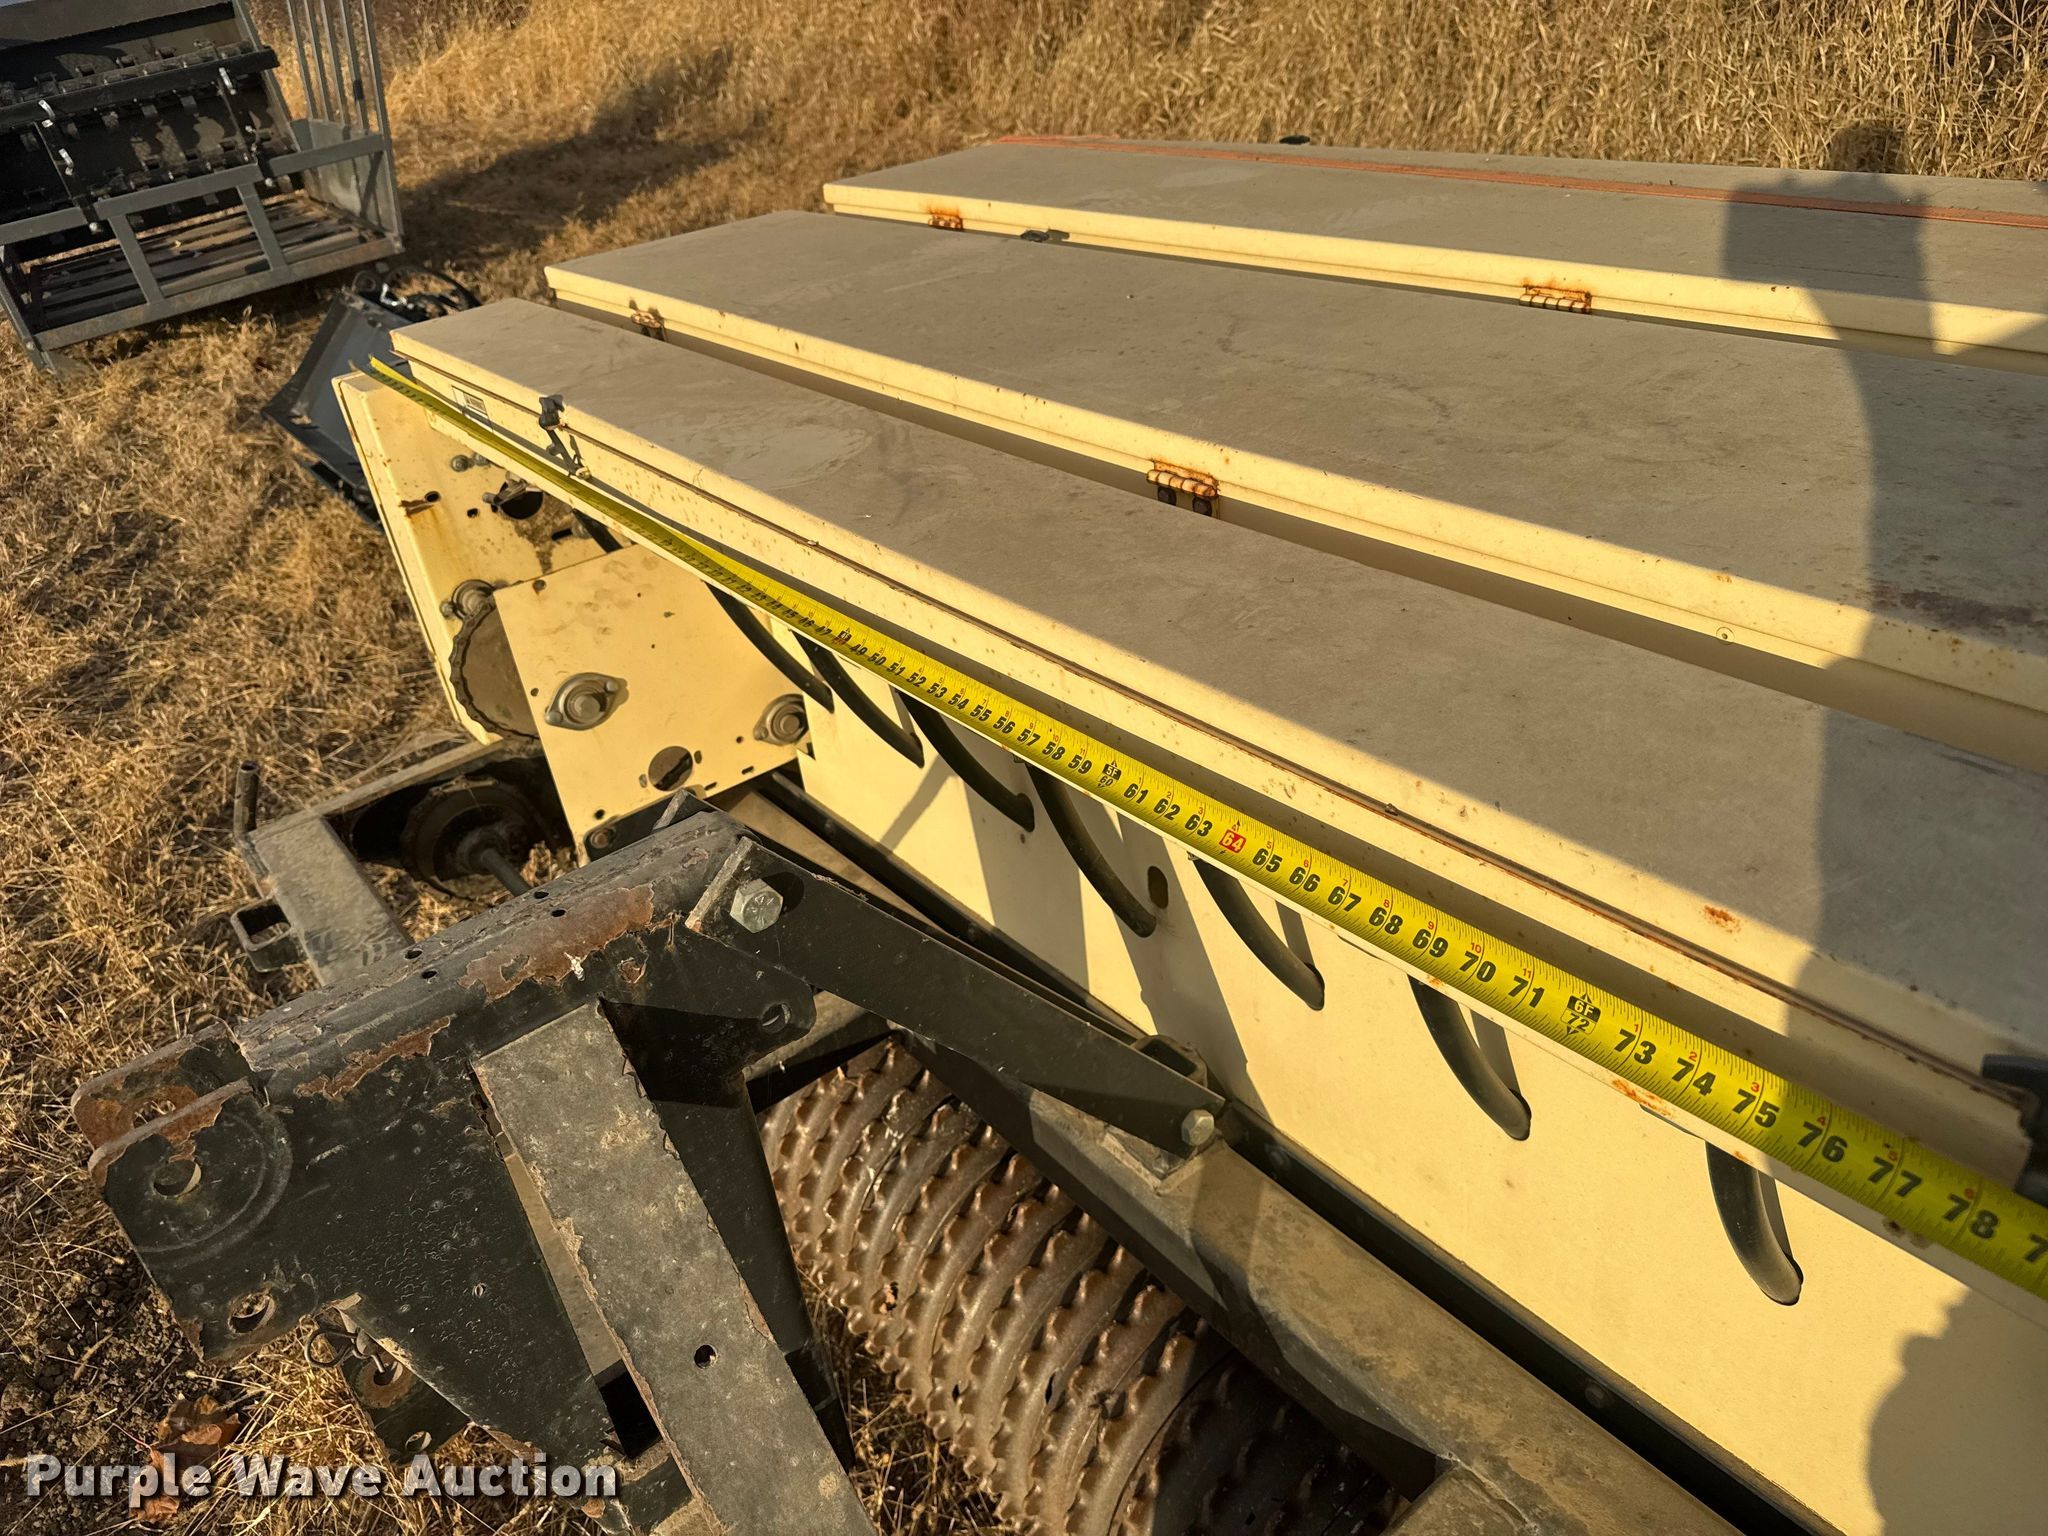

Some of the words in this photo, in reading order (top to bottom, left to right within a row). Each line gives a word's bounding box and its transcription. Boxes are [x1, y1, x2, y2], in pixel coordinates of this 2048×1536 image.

[1166, 790, 1172, 799] 2
[1197, 806, 1203, 815] 3
[1266, 840, 1272, 849] 5
[1303, 859, 1309, 868] 6
[1343, 878, 1349, 887] 7
[1383, 899, 1390, 908] 8
[1428, 921, 1435, 930] 9
[1470, 942, 1482, 954] 10
[1522, 967, 1532, 979] 11
[867, 652, 887, 666] 50
[886, 662, 906, 676] 51
[907, 673, 926, 688] 52
[927, 682, 947, 698] 53
[948, 694, 970, 711] 54
[970, 704, 992, 722] 55
[993, 716, 1016, 734] 56
[1017, 728, 1040, 747] 57
[1042, 741, 1066, 761] 58
[1068, 754, 1092, 774] 59
[1099, 775, 1114, 787] 60
[1123, 783, 1149, 804] 61
[1153, 798, 1181, 820] 62
[1184, 814, 1213, 837] 63
[1221, 832, 1244, 851] 64
[1252, 848, 1283, 873] 65
[1289, 866, 1321, 892] 66
[1327, 886, 1362, 912] 67
[1368, 906, 1403, 935] 68
[1412, 928, 1449, 958] 69
[1459, 951, 1496, 982] 70
[1508, 975, 1545, 1008] 71
[1567, 1013, 1590, 1032] 72
[1614, 1028, 1657, 1065] 73
[1671, 1057, 1716, 1096] 74
[1732, 1088, 1780, 1129] 75
[1797, 1121, 1848, 1162] 76
[1867, 1155, 1922, 1197] 77
[1943, 1194, 1999, 1239] 78
[2024, 1233, 2048, 1263] 7
[1574, 999, 1595, 1017] 6F
[1689, 1051, 1698, 1062] 2
[1750, 1081, 1760, 1093] 3
[1816, 1115, 1827, 1126] 4
